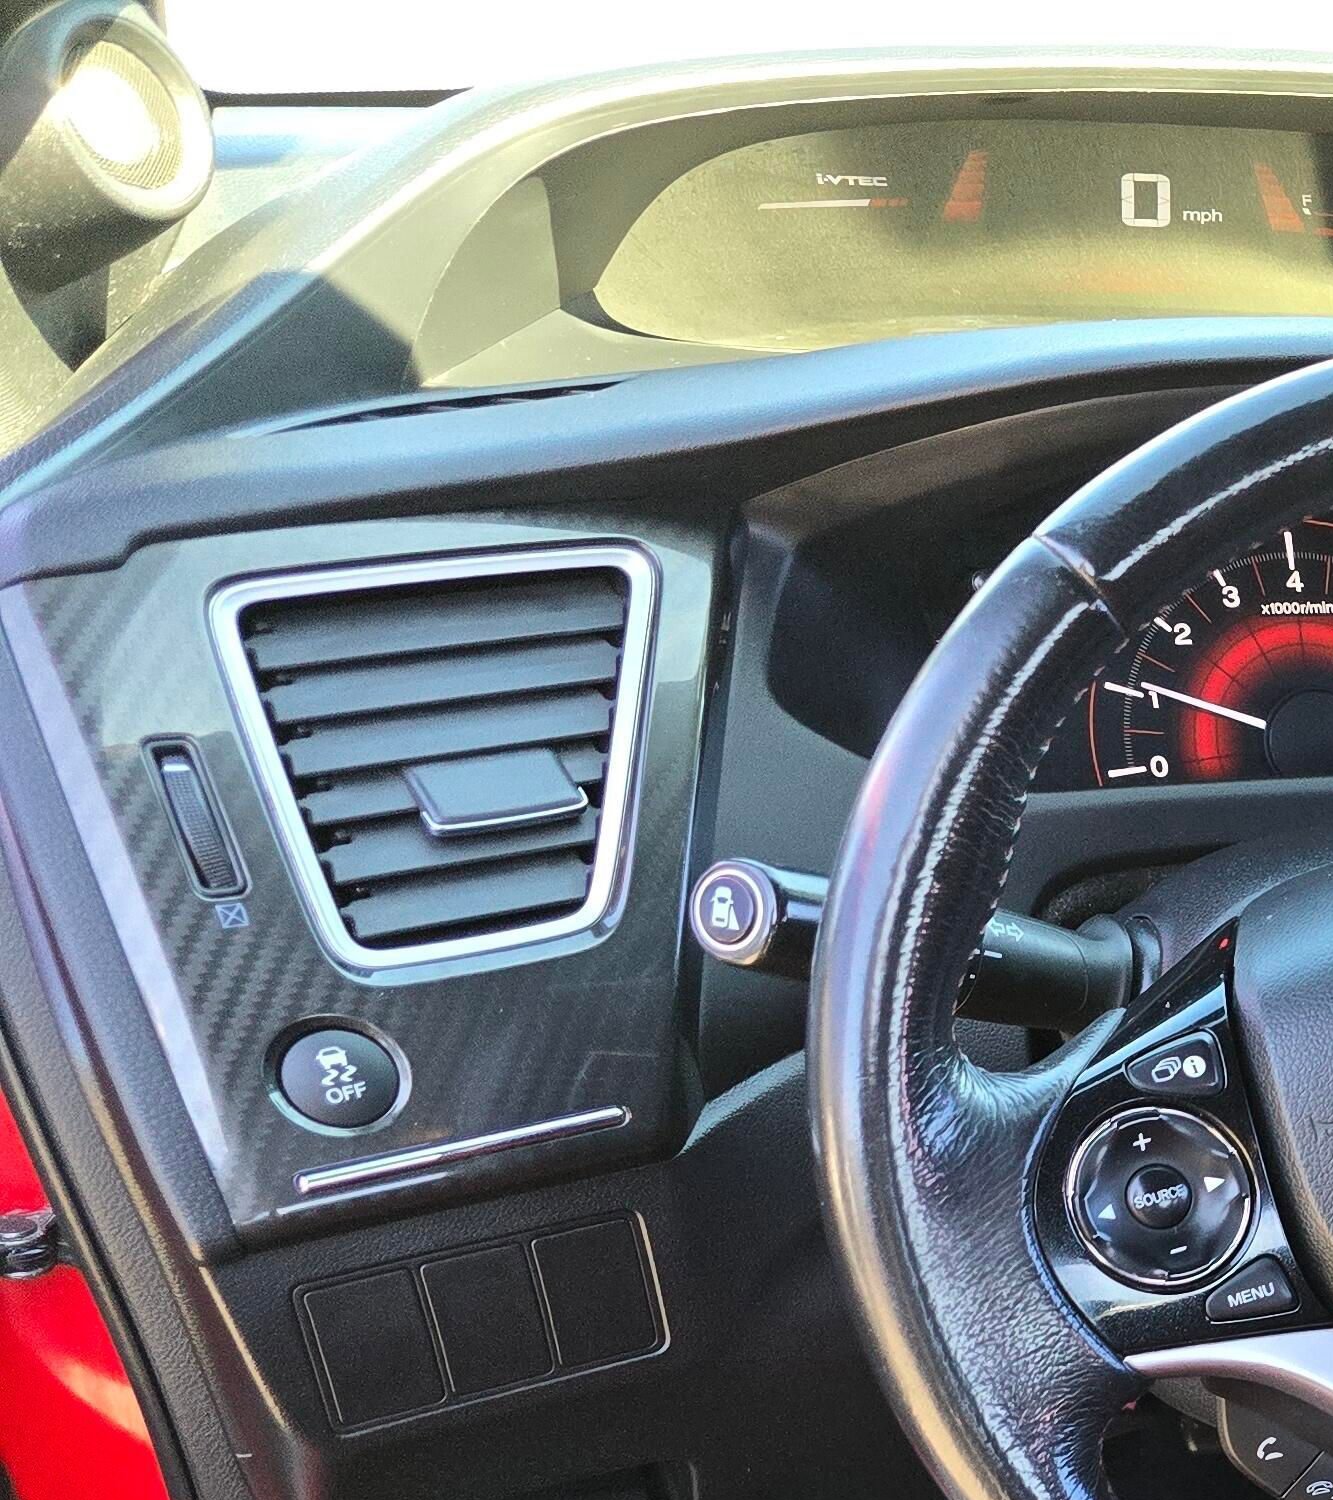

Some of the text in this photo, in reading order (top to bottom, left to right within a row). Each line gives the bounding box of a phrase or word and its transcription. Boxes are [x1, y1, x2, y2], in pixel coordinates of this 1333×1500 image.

[1121, 173, 1222, 227] 0 mph
[1302, 194, 1312, 206] F
[1285, 571, 1305, 593] 4
[1221, 587, 1241, 609] 3
[1173, 623, 1193, 646] 2
[1148, 689, 1160, 709] 1
[1150, 755, 1169, 778] 0
[325, 1081, 367, 1104] OFF
[1133, 1183, 1186, 1209] SOURCE
[1227, 1282, 1276, 1308] MENU
